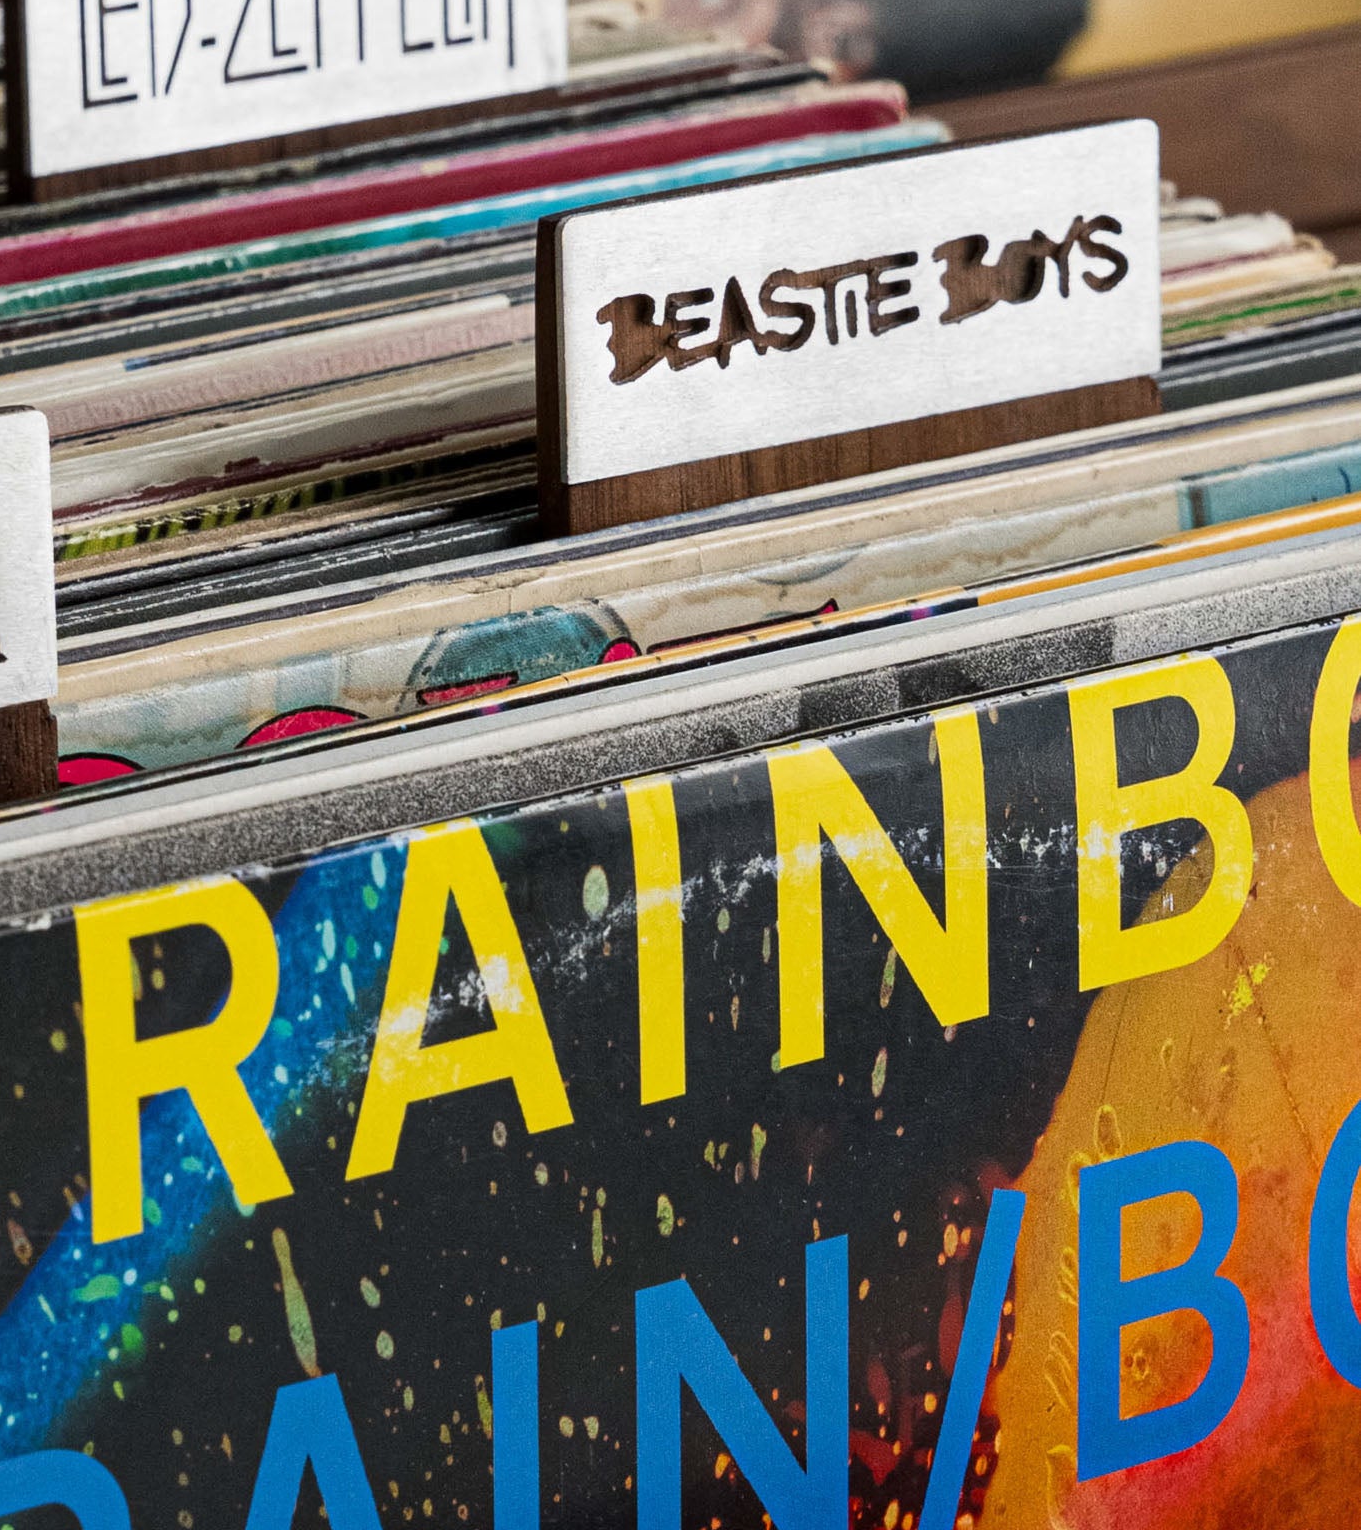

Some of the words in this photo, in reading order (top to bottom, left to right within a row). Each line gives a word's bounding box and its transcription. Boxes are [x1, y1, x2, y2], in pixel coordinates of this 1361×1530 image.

[596, 250, 920, 386] BEASTIE
[932, 214, 1129, 325] BOYS
[70, 613, 1361, 1247] RAINB
